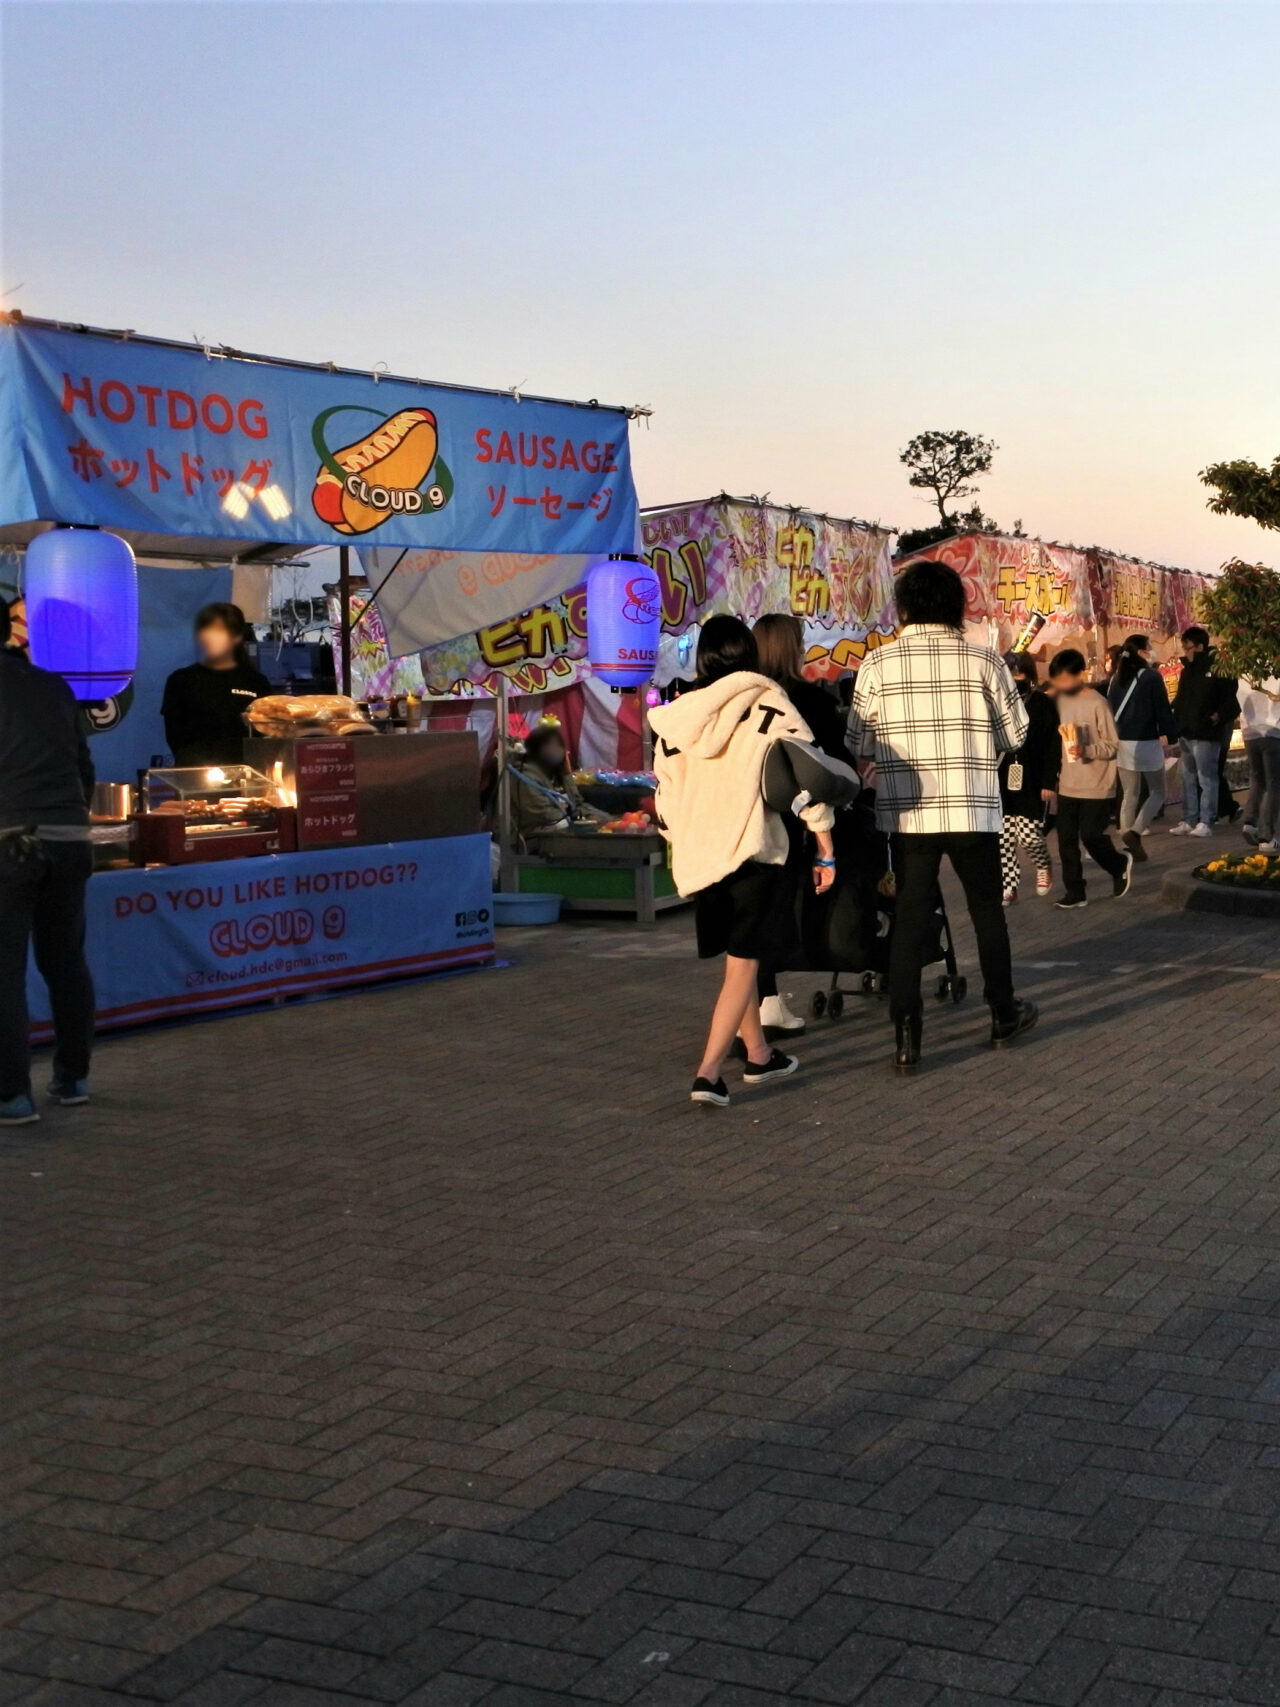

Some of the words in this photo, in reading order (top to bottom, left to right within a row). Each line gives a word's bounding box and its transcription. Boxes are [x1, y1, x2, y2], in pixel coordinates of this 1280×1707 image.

[61, 372, 268, 440] HOTDOG
[67, 438, 272, 501] ホットドッグ
[474, 427, 618, 474] SAUSAGE
[345, 472, 423, 515] CLOUD
[428, 484, 446, 510] 9
[487, 484, 614, 522] ソーセージ
[304, 812, 356, 828] ホットドッグ
[115, 891, 157, 919] DO
[166, 885, 224, 912] YOU
[234, 876, 287, 904] LIKE
[295, 862, 419, 895] HOTDOG??
[209, 909, 315, 958] CLOUD
[322, 905, 346, 940] 9
